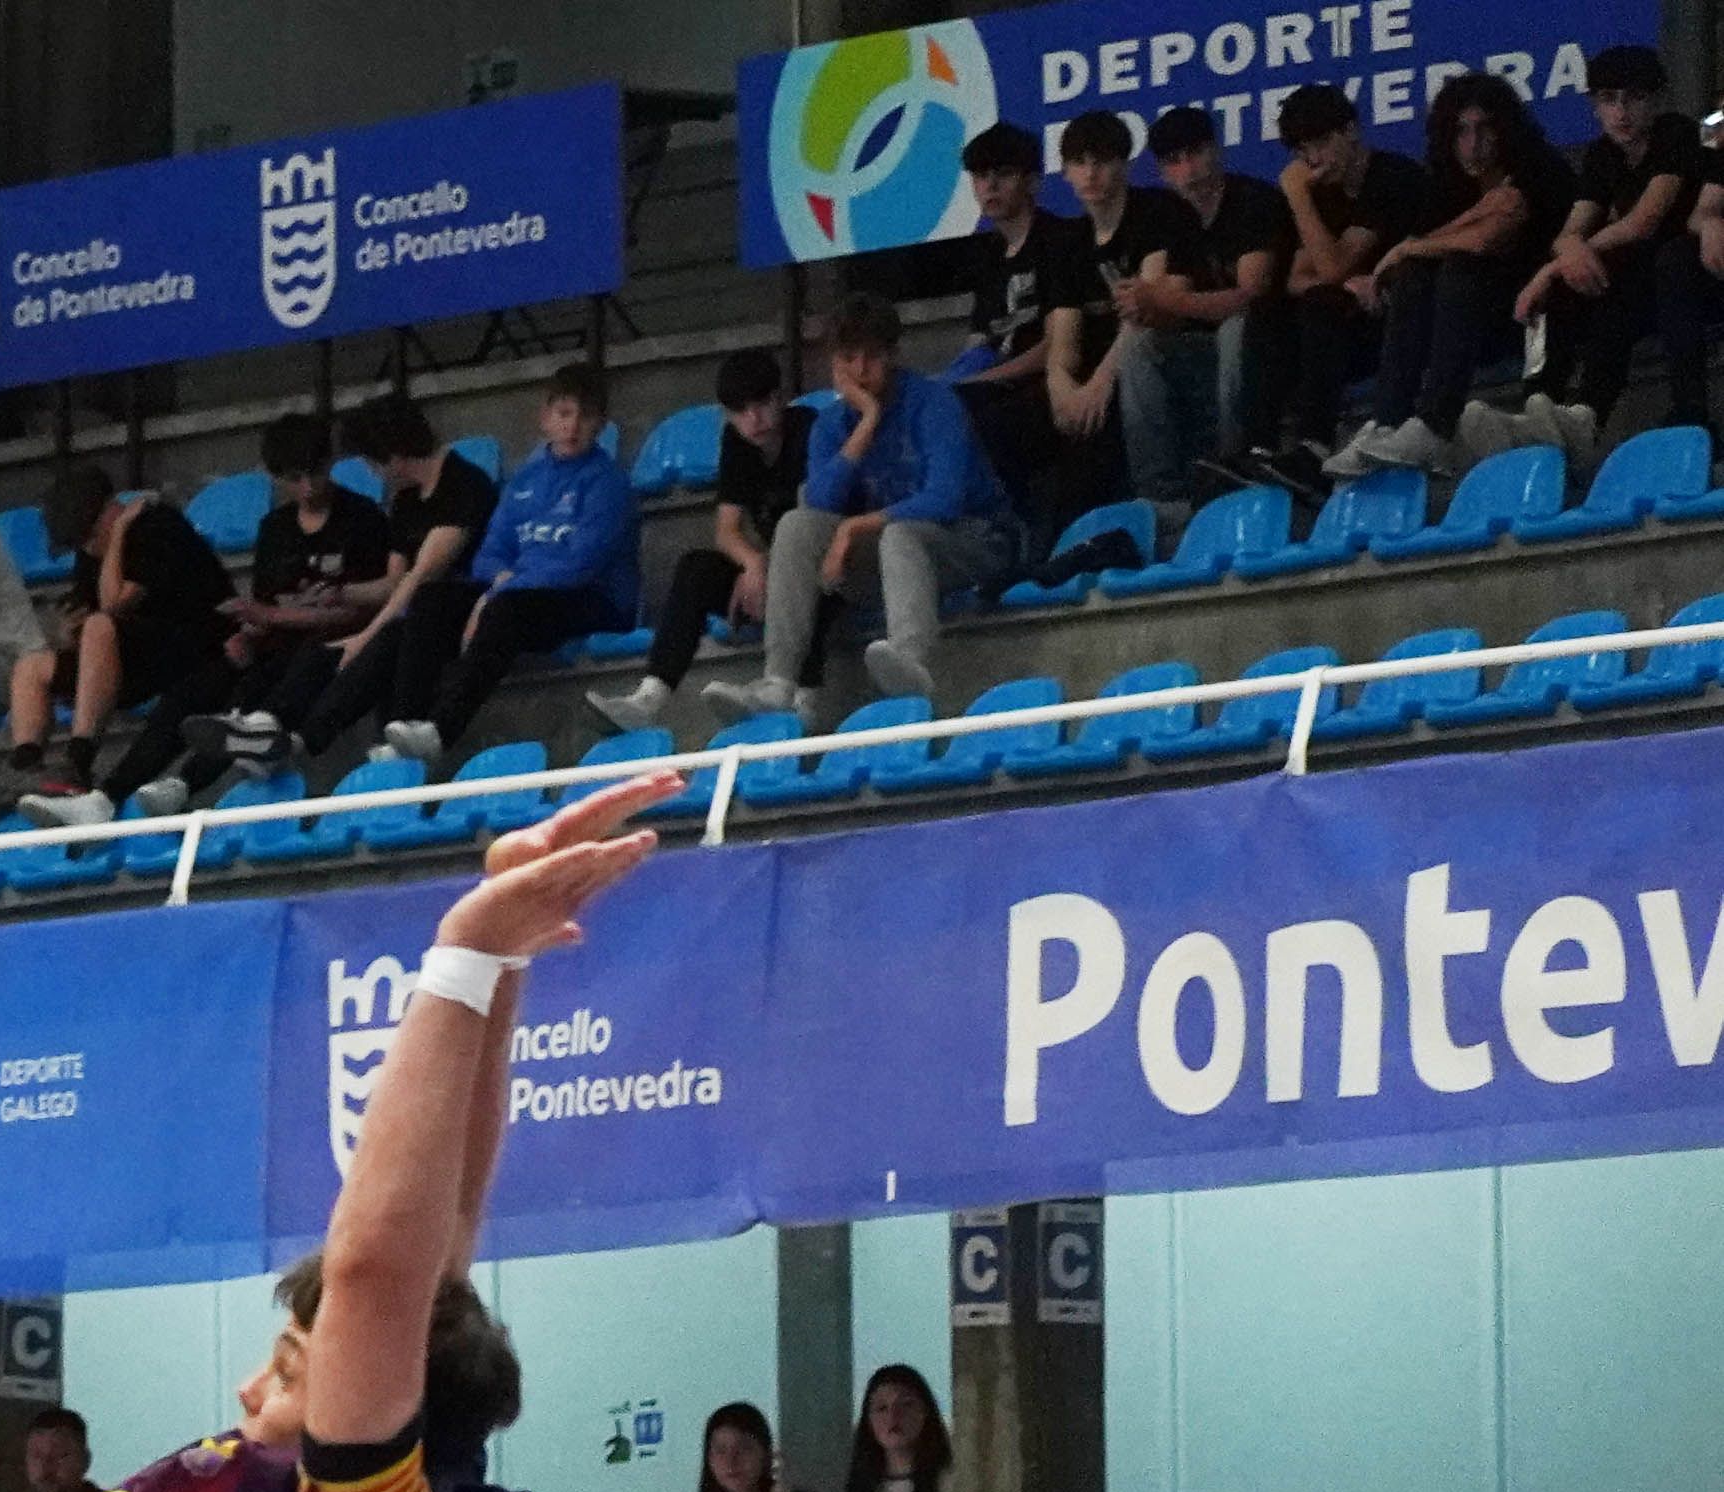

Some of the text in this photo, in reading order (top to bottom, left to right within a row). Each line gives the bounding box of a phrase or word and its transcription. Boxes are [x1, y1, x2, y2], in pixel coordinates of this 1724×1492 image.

[1042, 0, 1415, 104] DEPORTE
[354, 180, 468, 230] Concello
[13, 239, 120, 287] Concello
[355, 211, 546, 272] de Pontevedra
[13, 269, 195, 329] de Pontevedra
[1004, 863, 1724, 1127] Pontev
[509, 1009, 613, 1062] ncello
[0, 1052, 85, 1087] DEPORTE
[509, 1061, 723, 1123] Pontevedra
[961, 1234, 999, 1293] C
[1048, 1232, 1092, 1290] C
[11, 1315, 52, 1371] C
